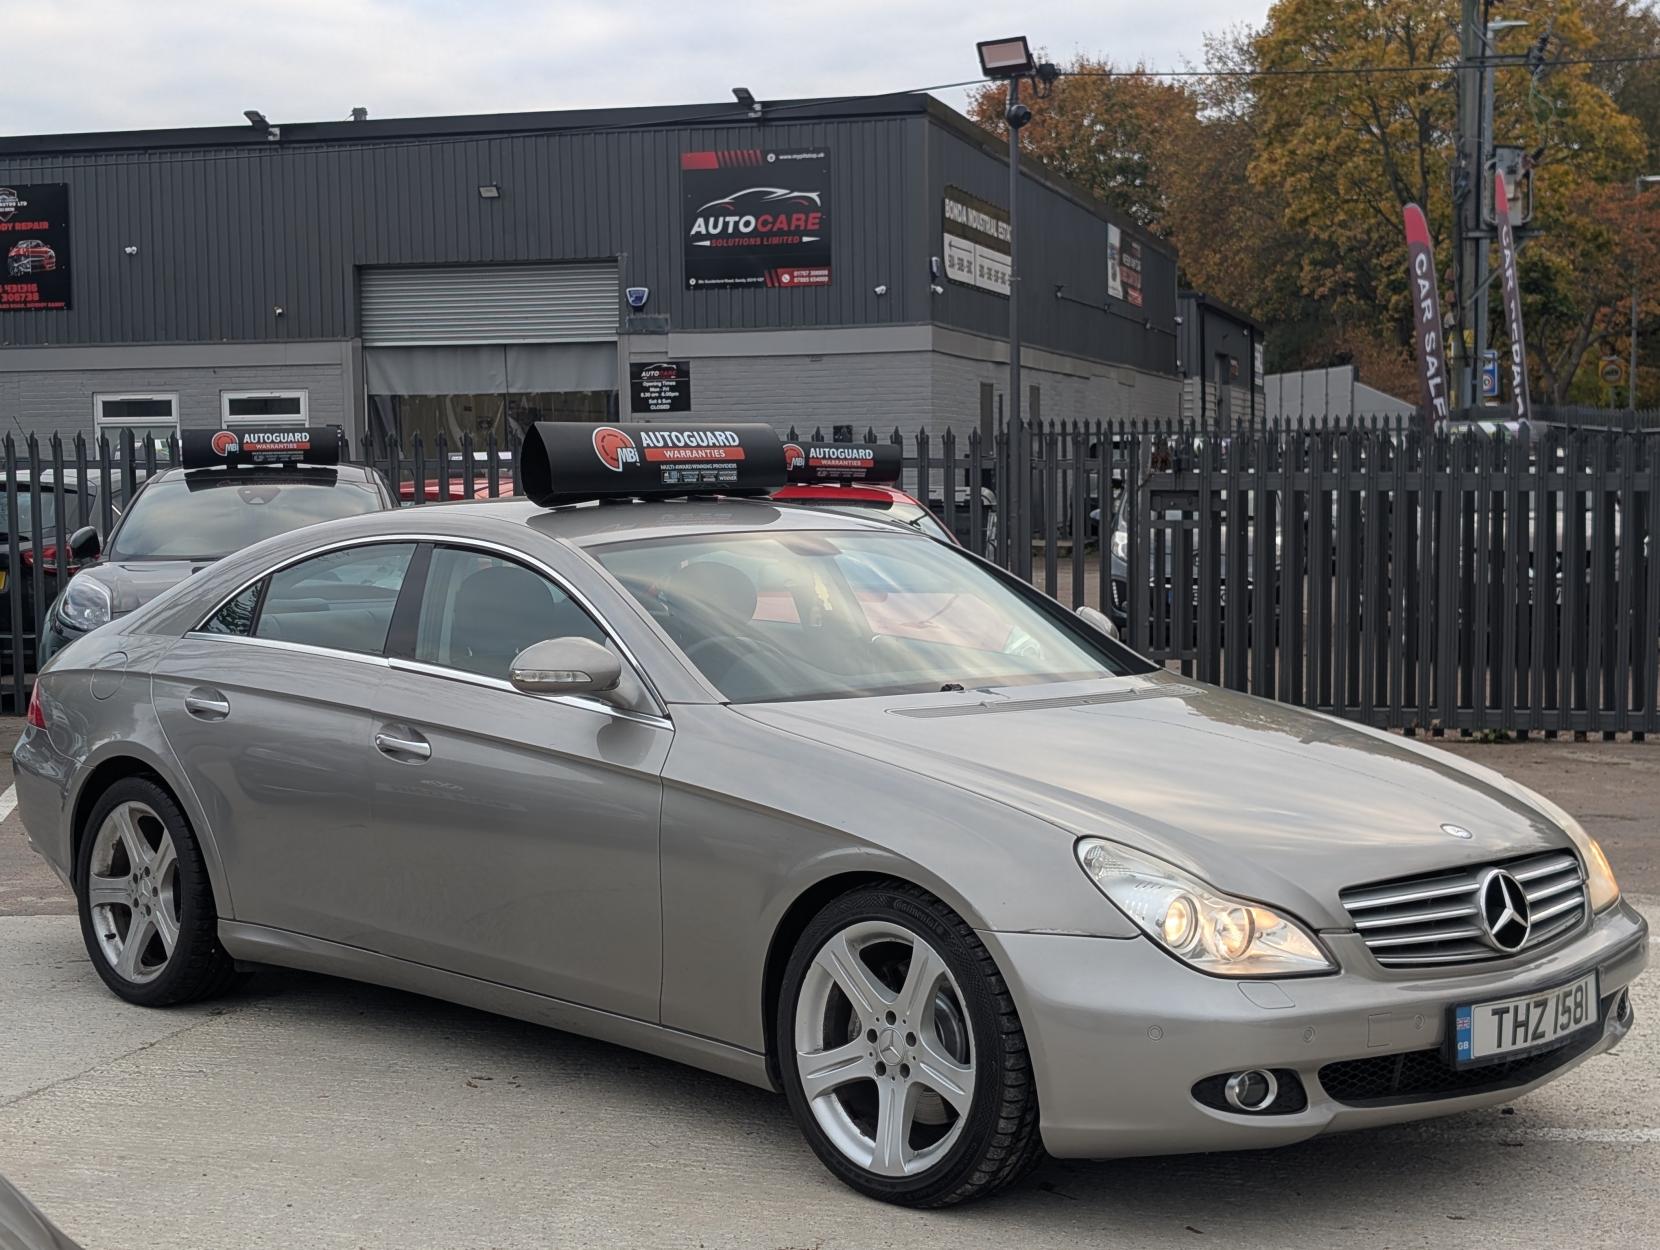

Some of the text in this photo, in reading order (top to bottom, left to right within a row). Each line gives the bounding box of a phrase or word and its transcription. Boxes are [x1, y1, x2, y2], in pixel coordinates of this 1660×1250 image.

[15, 221, 49, 230] REPAIR
[690, 212, 822, 235] AUTOCARE
[967, 208, 997, 238] INDUSTRIAL
[998, 220, 1011, 242] ESTA
[710, 236, 800, 247] SOLUTIONS LIMITED
[1415, 252, 1434, 323] CAR
[243, 432, 310, 443] AUTOGUARD
[640, 431, 740, 448] AUTOGUARD
[664, 449, 725, 459] WARRANTIES
[809, 447, 873, 459] AUTOGUARD
[1491, 980, 1589, 1049] THZ 1581
[1457, 1040, 1470, 1050] GB
